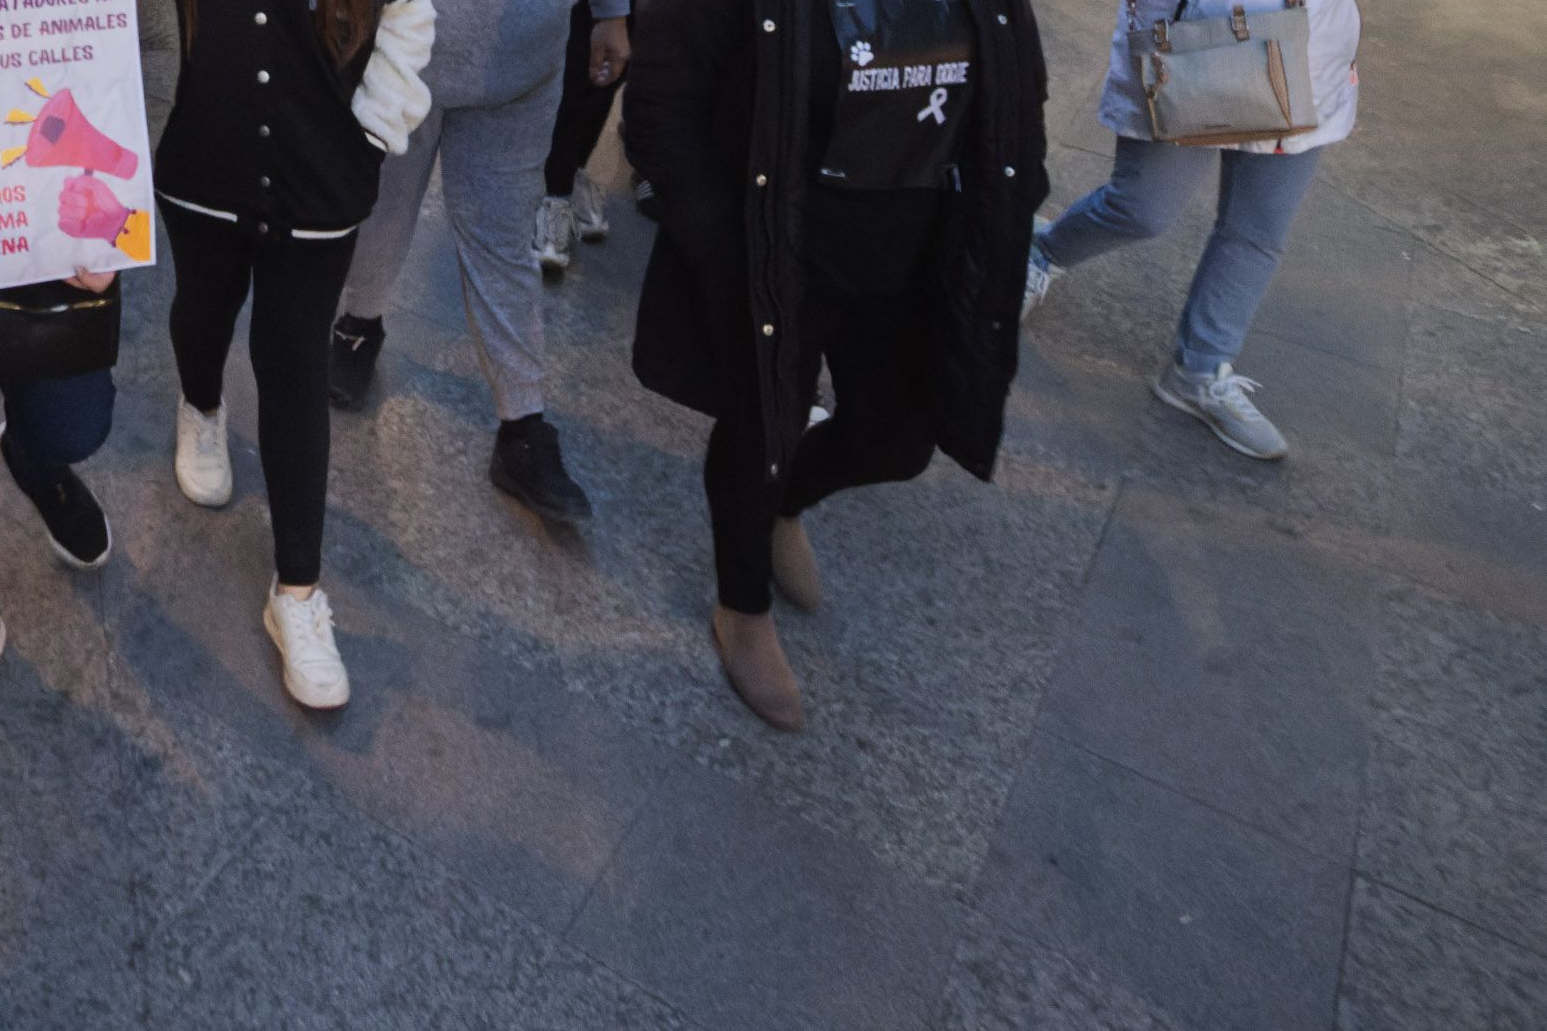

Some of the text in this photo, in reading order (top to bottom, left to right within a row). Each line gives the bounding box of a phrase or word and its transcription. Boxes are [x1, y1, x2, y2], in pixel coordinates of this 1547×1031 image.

[11, 22, 32, 39] DE
[39, 13, 128, 37] ANIMALES
[29, 44, 94, 67] CALLES
[847, 67, 900, 91] JUSTICIA
[902, 65, 932, 88] PARA
